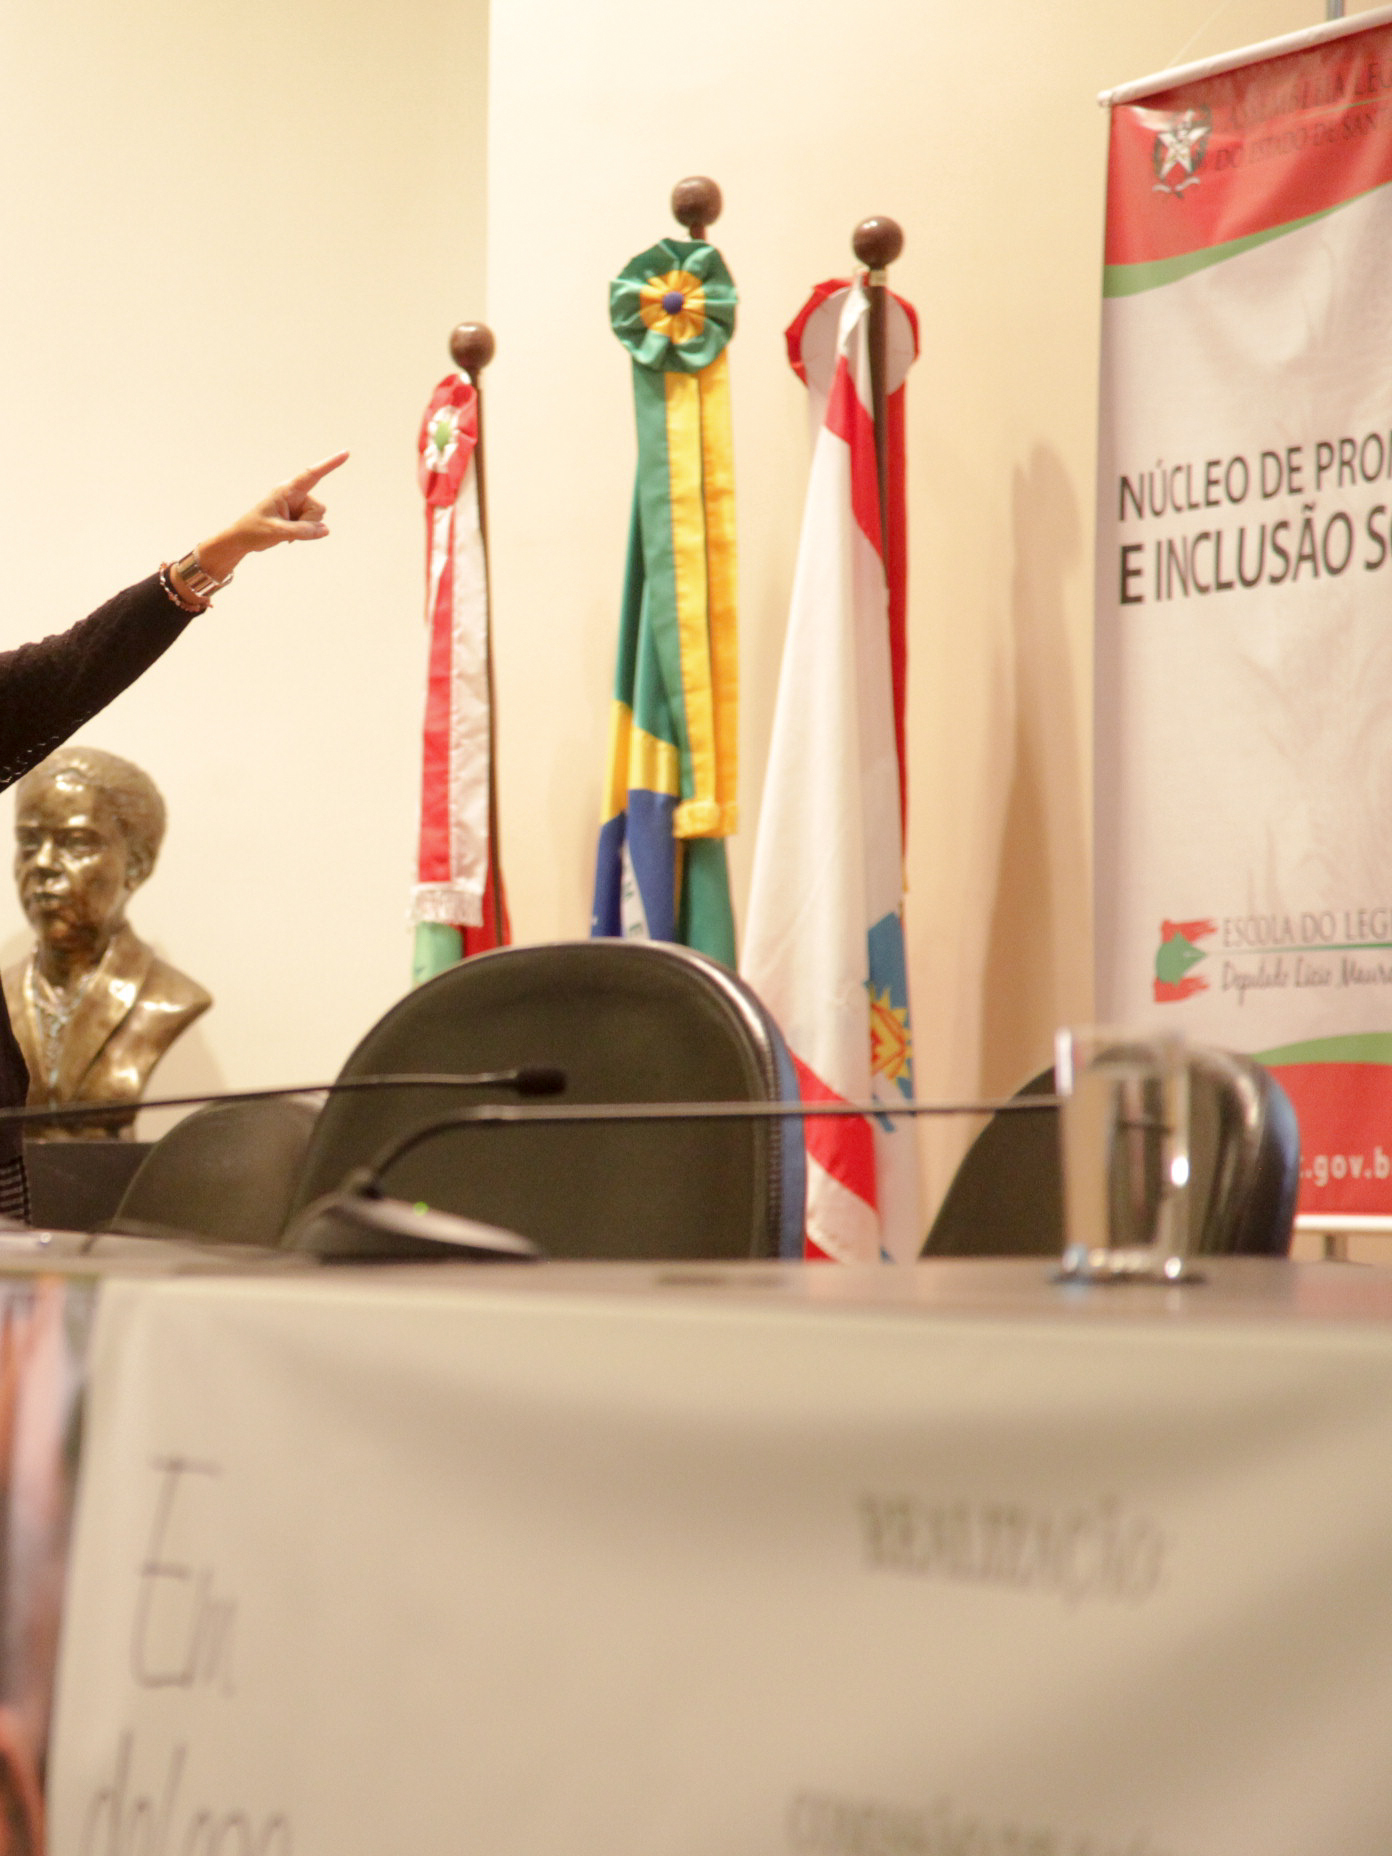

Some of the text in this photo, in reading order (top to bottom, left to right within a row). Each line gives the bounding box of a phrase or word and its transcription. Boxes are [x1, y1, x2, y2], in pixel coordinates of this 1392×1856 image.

[1119, 430, 1392, 522] NÚCLEO DE PRO
[1120, 501, 1392, 605] E INCLUSÃO S
[1222, 913, 1296, 948] ESCOLA
[1300, 909, 1337, 944] DO
